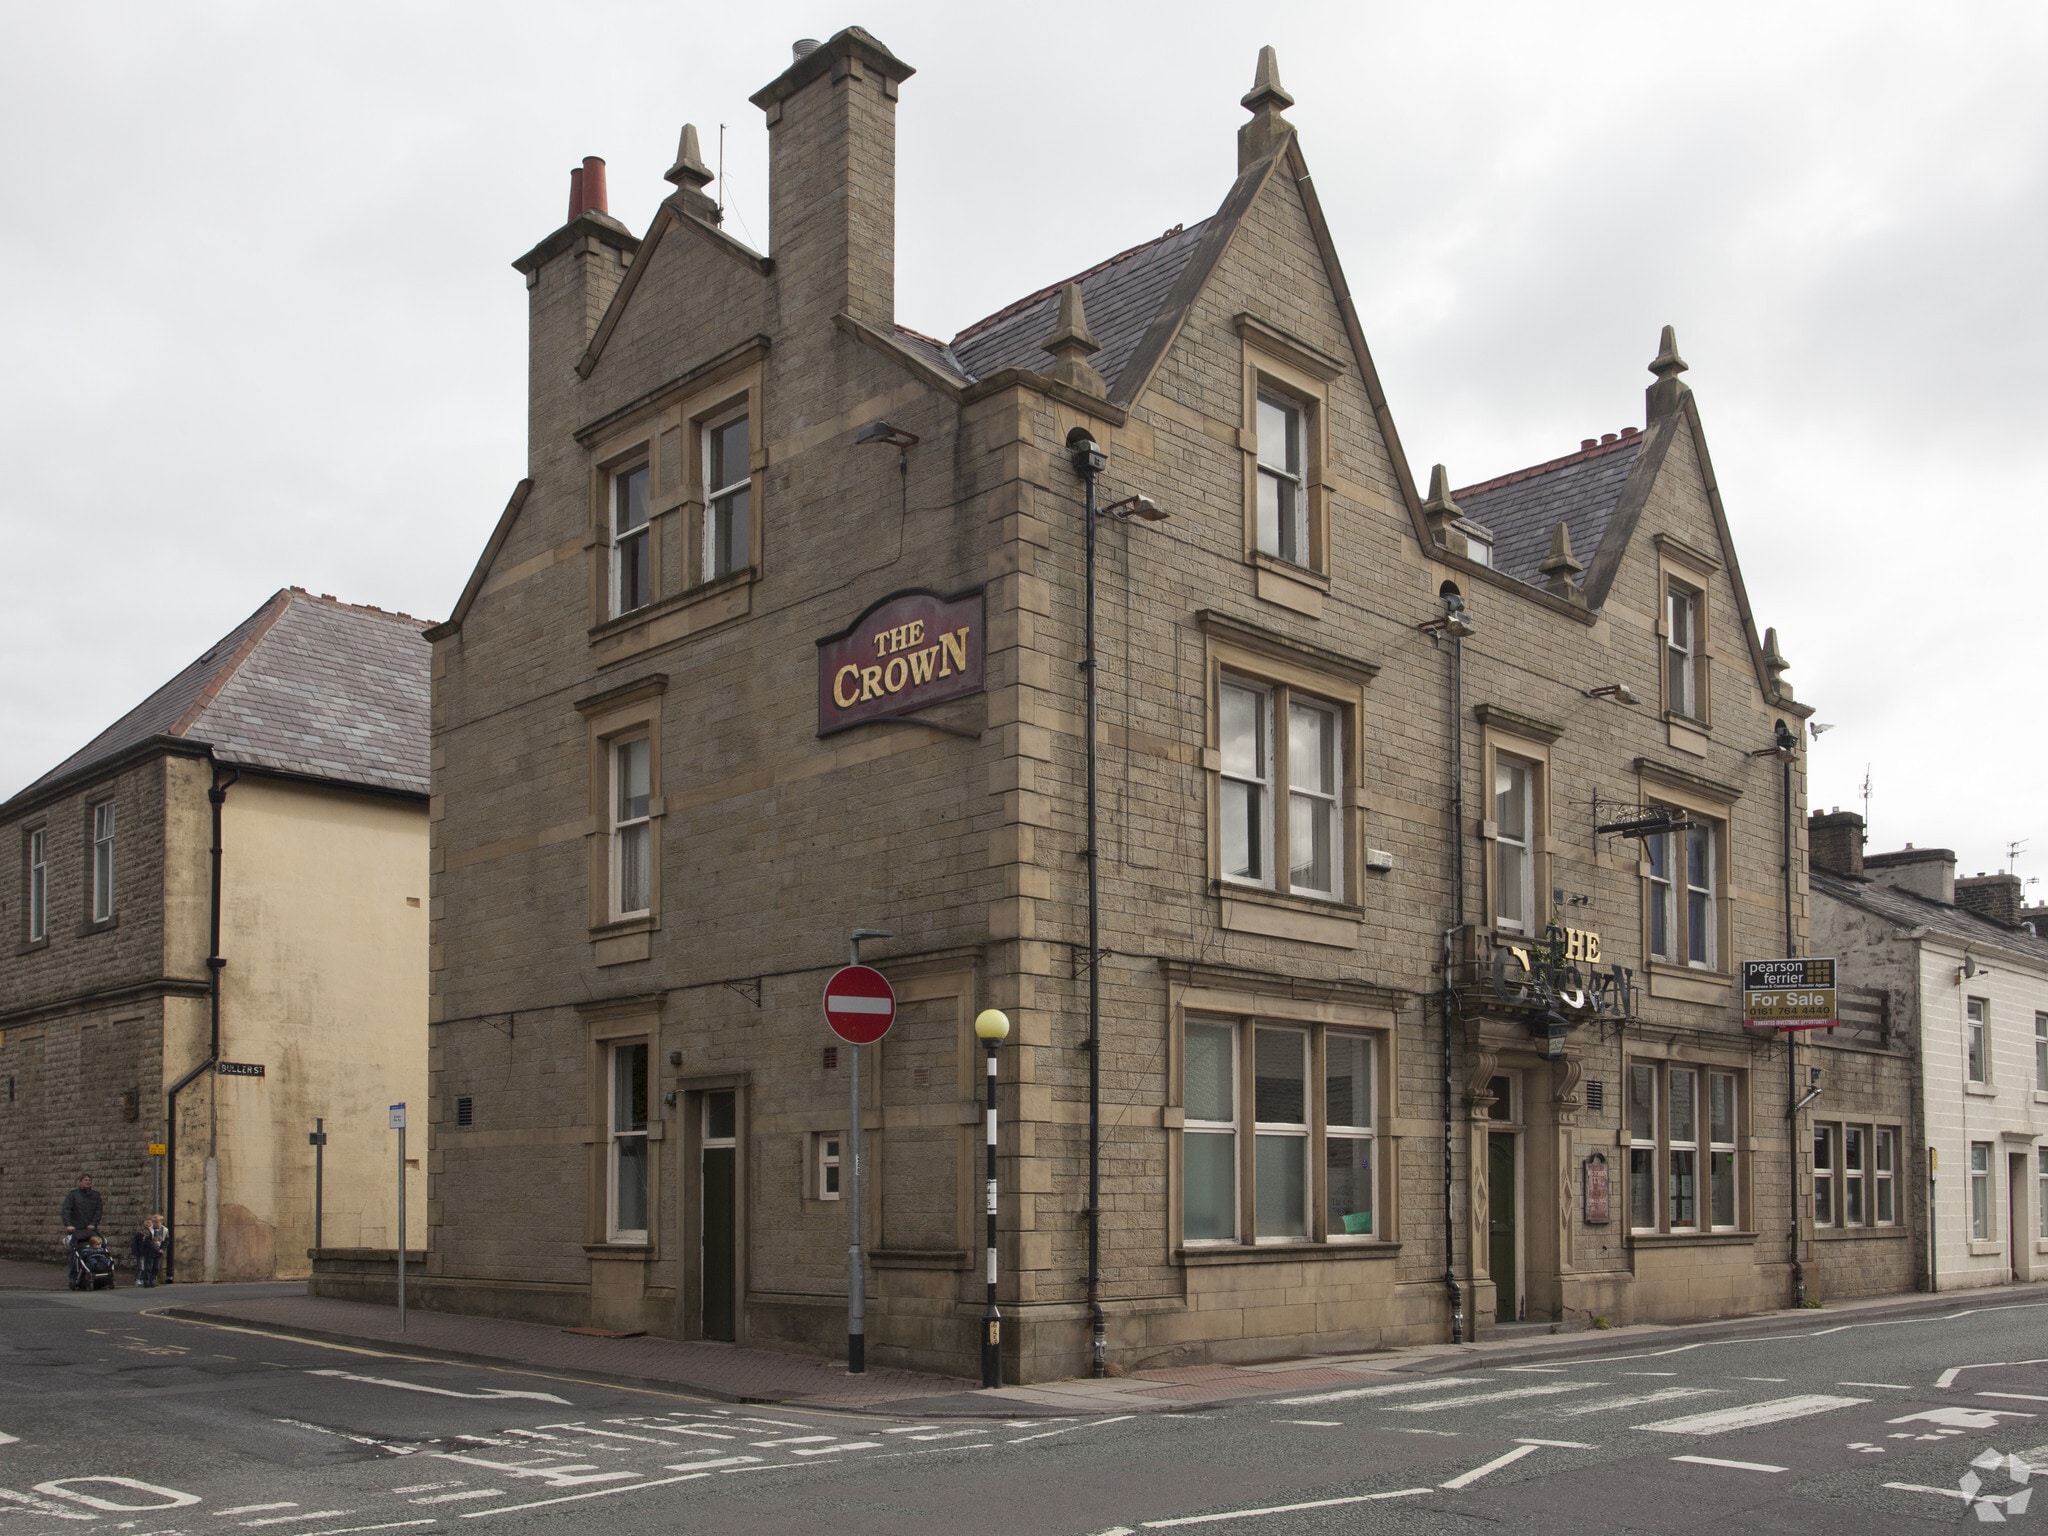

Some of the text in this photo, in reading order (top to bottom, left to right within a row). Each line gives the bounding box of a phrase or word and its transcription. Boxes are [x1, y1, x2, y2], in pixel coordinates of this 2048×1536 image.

[873, 619, 925, 658] THE
[833, 626, 970, 709] CROWN
[1546, 925, 1601, 964] THE
[1749, 962, 1803, 976] pearson
[1764, 972, 1804, 984] ferrier
[1751, 992, 1825, 1007] For Sale
[1749, 1006, 1830, 1016] 0161 764 4440
[221, 1064, 253, 1074] BULLER
